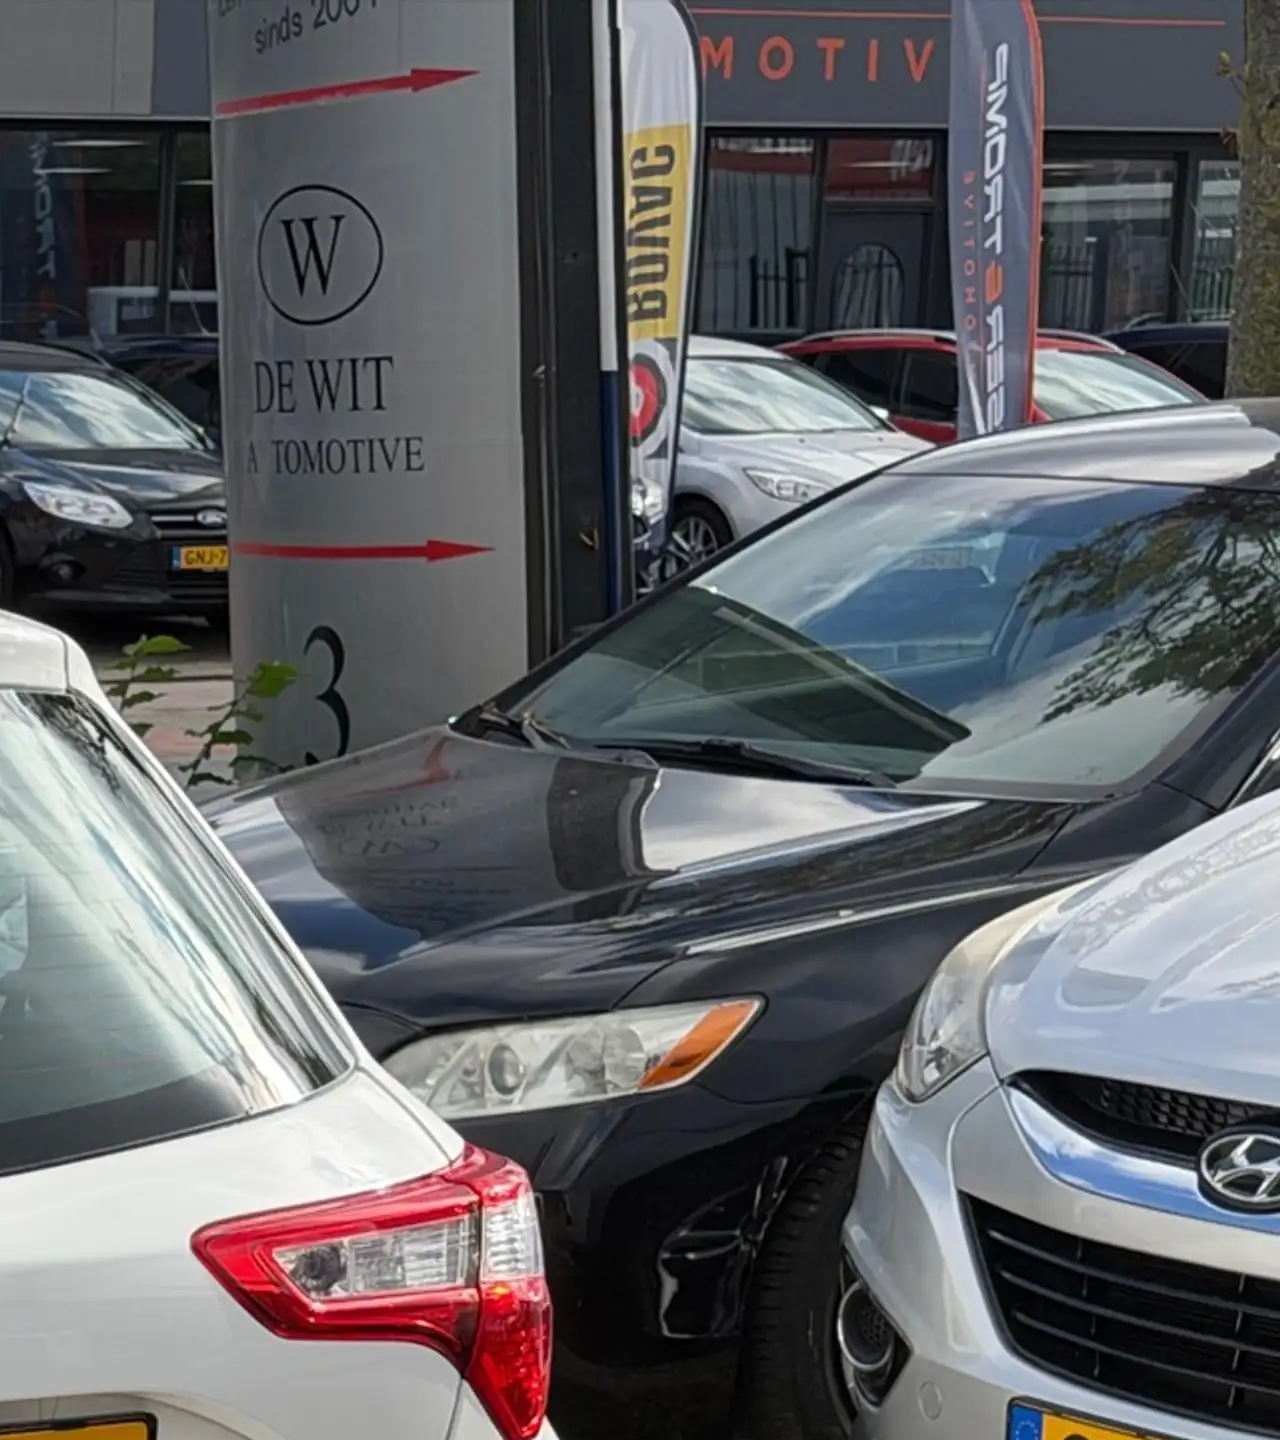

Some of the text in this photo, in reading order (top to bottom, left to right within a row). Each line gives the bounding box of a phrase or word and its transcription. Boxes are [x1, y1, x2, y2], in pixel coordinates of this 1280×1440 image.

[253, 6, 304, 55] sinds
[310, 0, 377, 30] 200
[279, 214, 347, 299] W
[254, 355, 394, 414] DE WIT
[302, 624, 351, 768] 3
